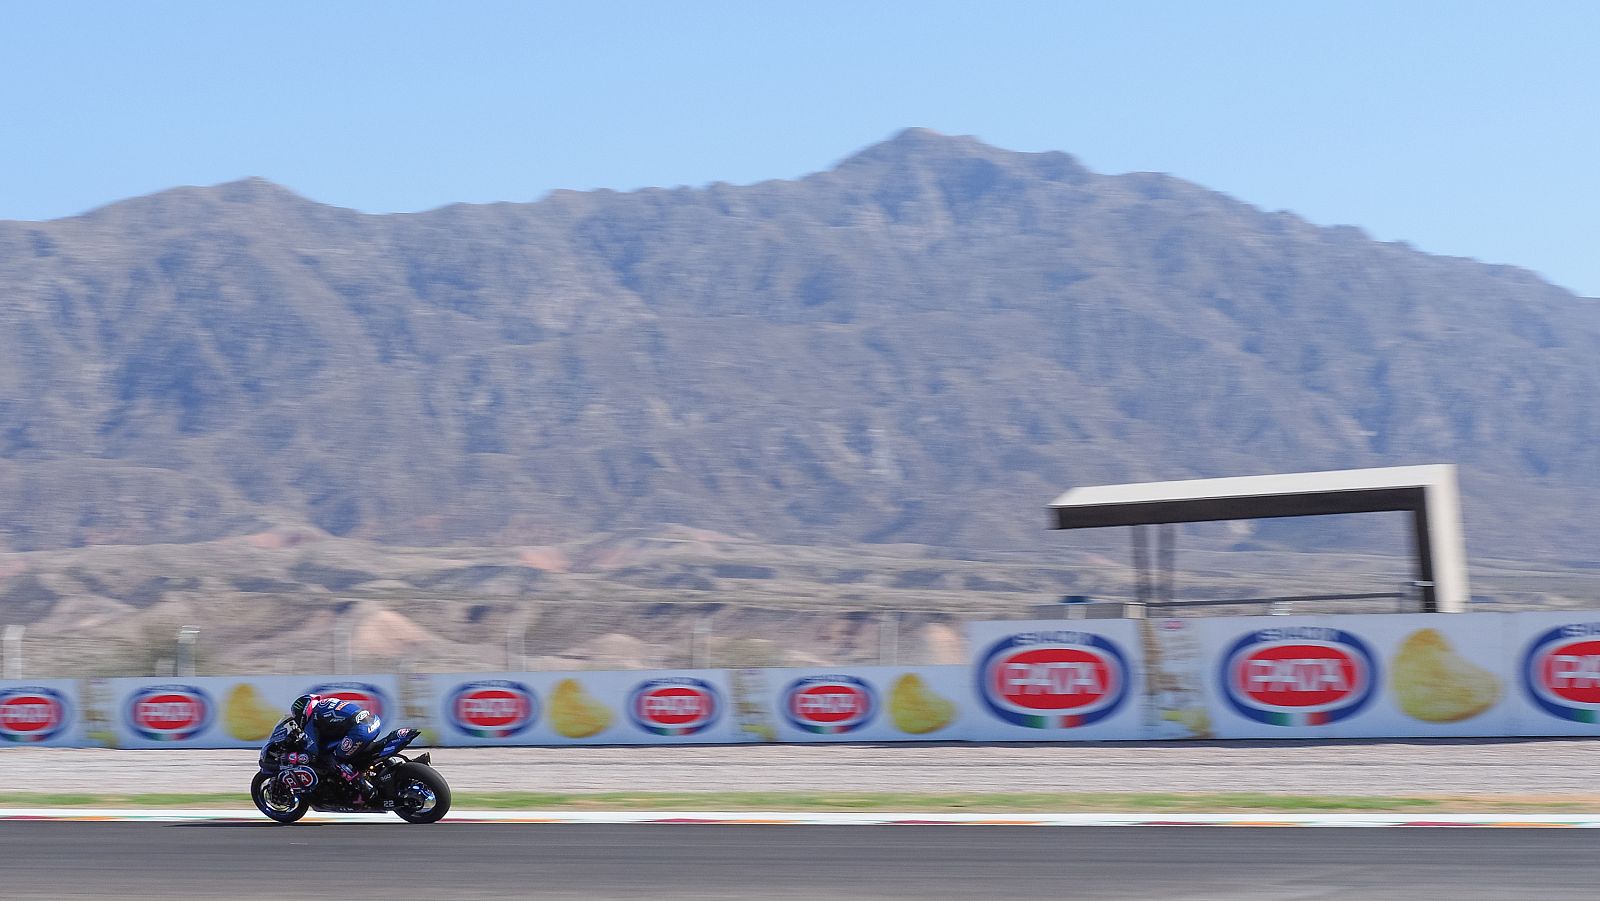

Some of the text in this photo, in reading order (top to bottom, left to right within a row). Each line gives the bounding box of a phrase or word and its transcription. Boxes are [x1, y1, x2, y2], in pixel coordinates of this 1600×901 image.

[1001, 662, 1105, 695] PATA
[1248, 658, 1352, 692] PATA
[1552, 654, 1600, 689] PA
[136, 702, 202, 722] PATA
[460, 698, 525, 718] PATA
[640, 695, 707, 716] PATA
[795, 693, 863, 714] PATA
[383, 800, 395, 808] 22
